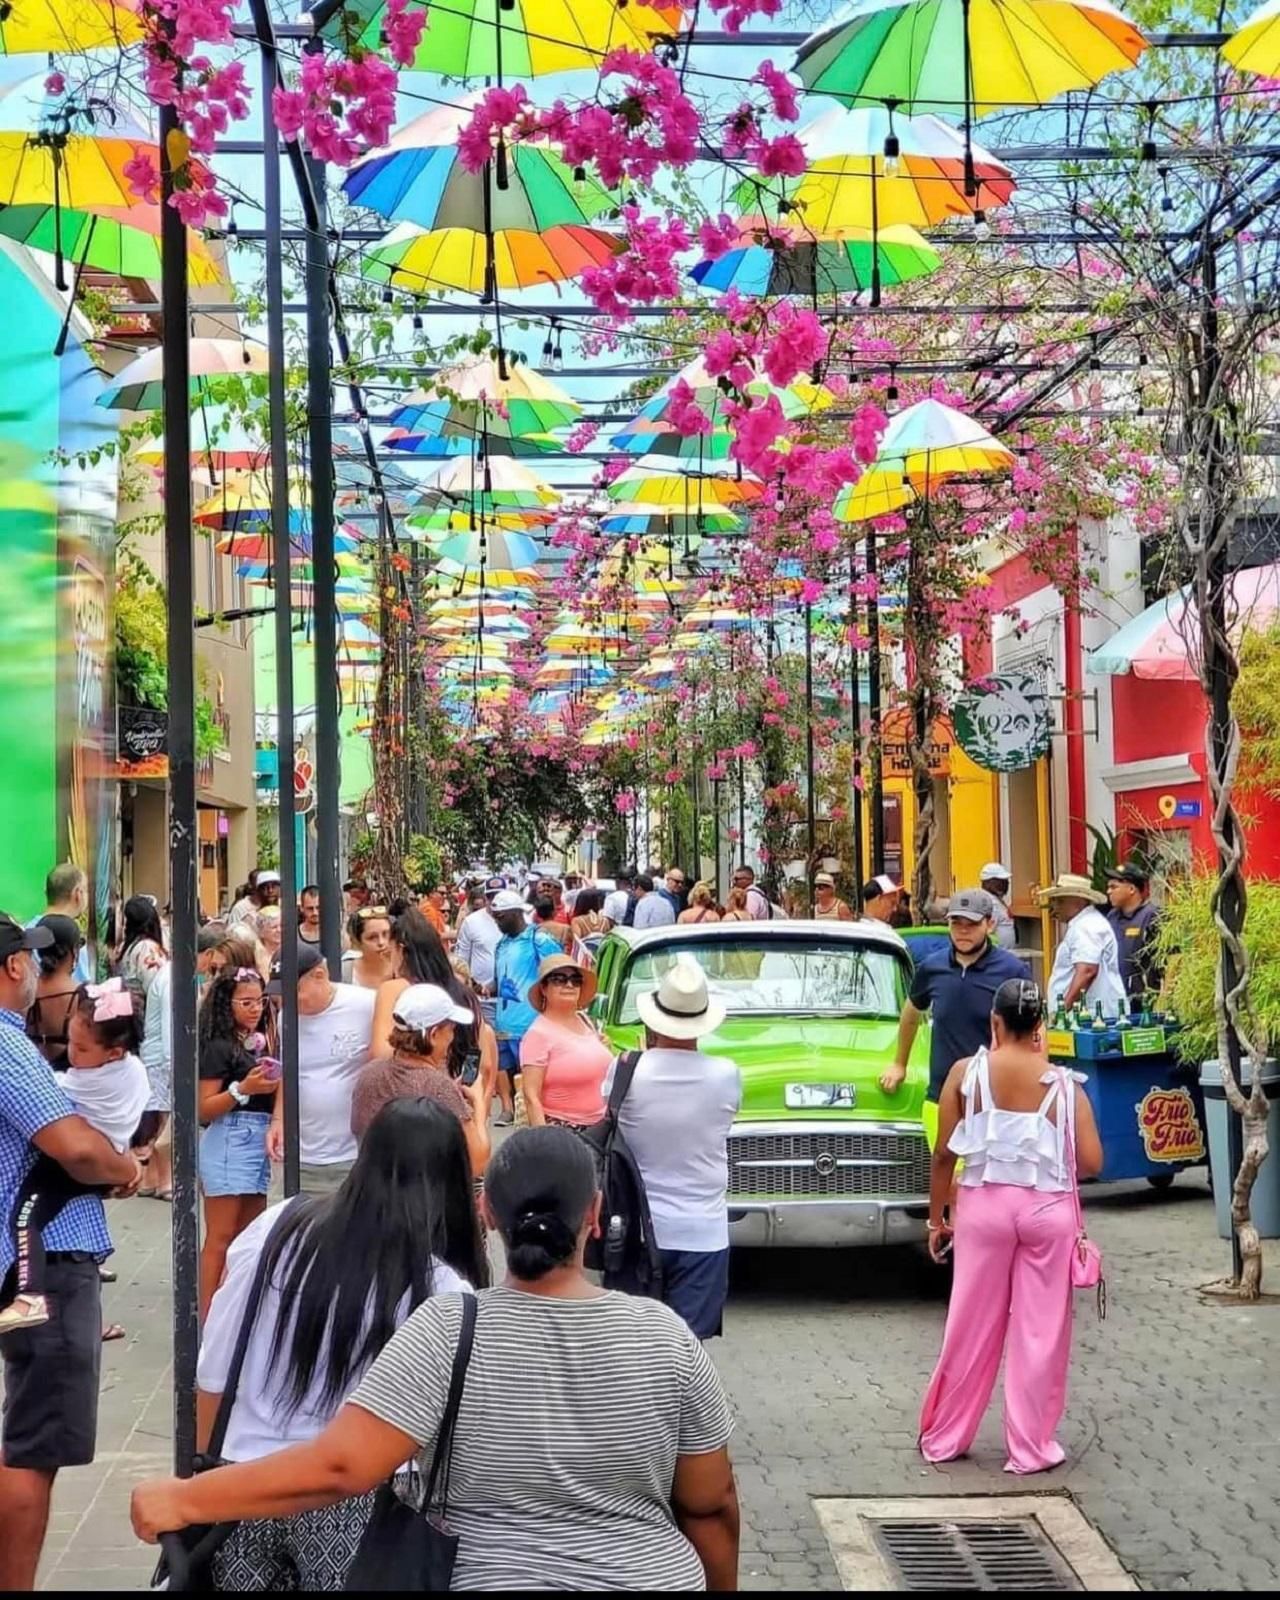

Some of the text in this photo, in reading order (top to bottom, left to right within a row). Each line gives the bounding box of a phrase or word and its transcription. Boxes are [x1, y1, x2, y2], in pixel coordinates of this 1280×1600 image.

[883, 742, 950, 756] Emna
[891, 756, 942, 770] hose
[1143, 1095, 1189, 1126] Frio
[1150, 1121, 1197, 1152] Frio
[16, 1200, 35, 1228] GOOD
